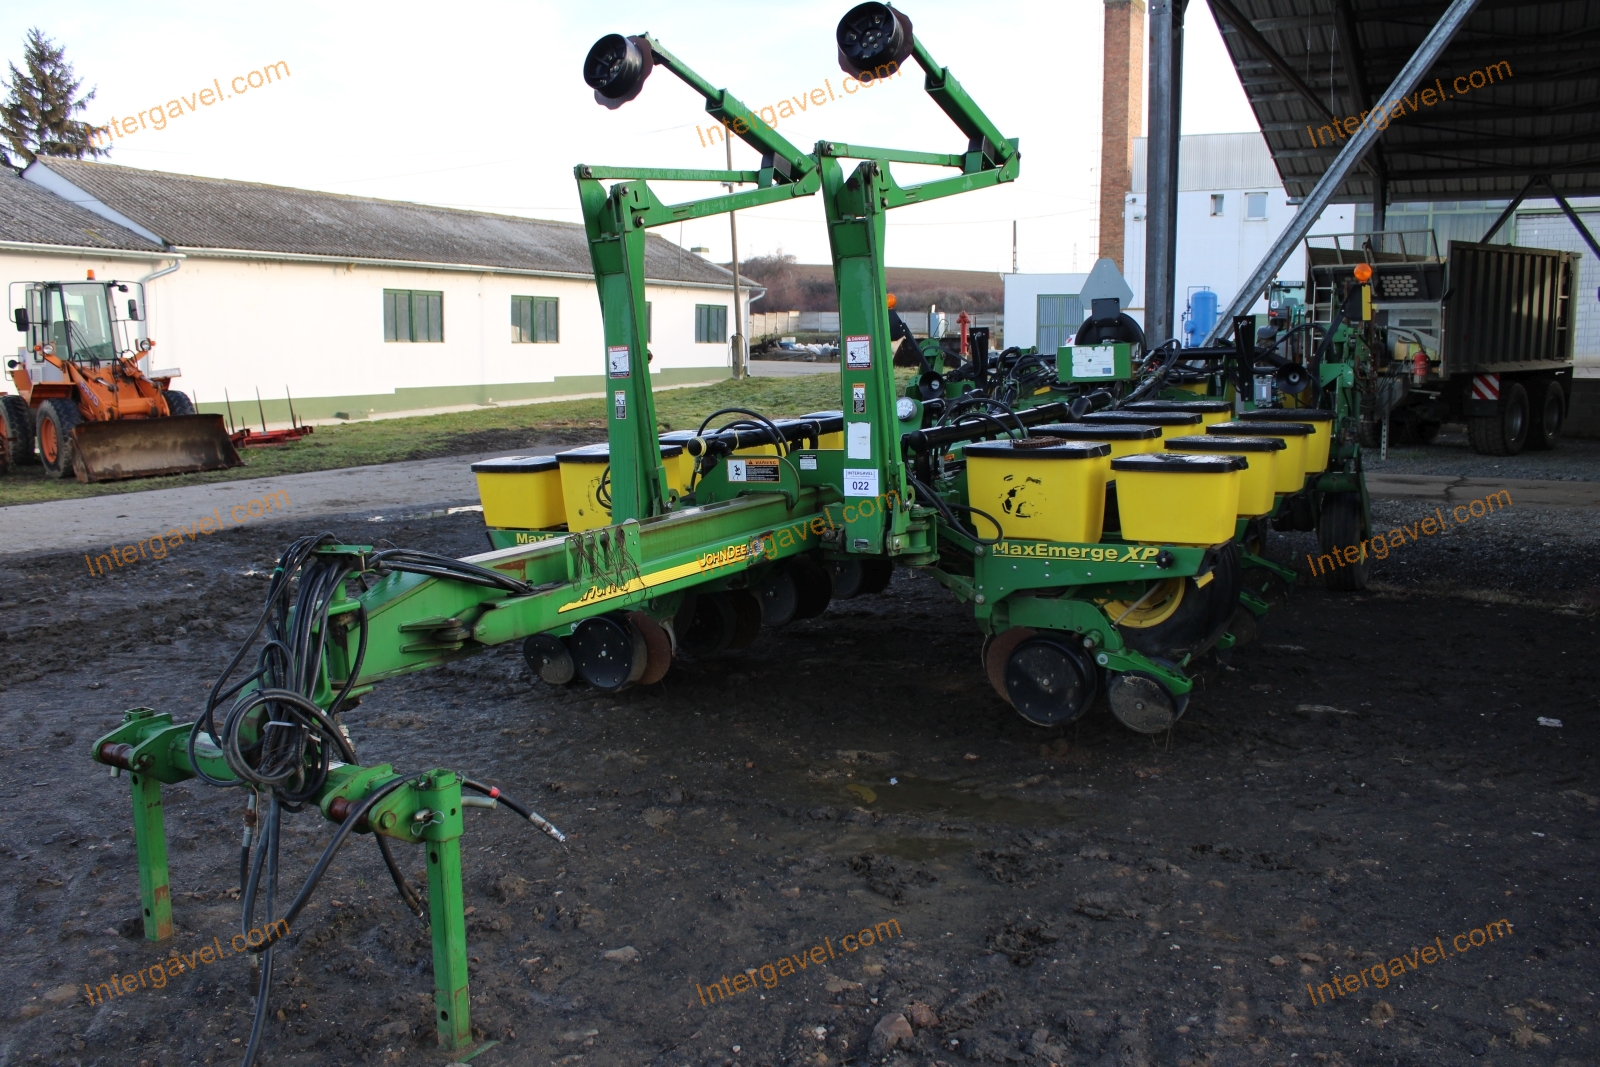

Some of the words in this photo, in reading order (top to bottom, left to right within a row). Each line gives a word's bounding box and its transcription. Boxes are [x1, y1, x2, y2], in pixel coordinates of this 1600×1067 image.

[852, 481, 869, 491] 022
[992, 541, 1119, 562] MaxEmerge
[1117, 546, 1160, 563] XP
